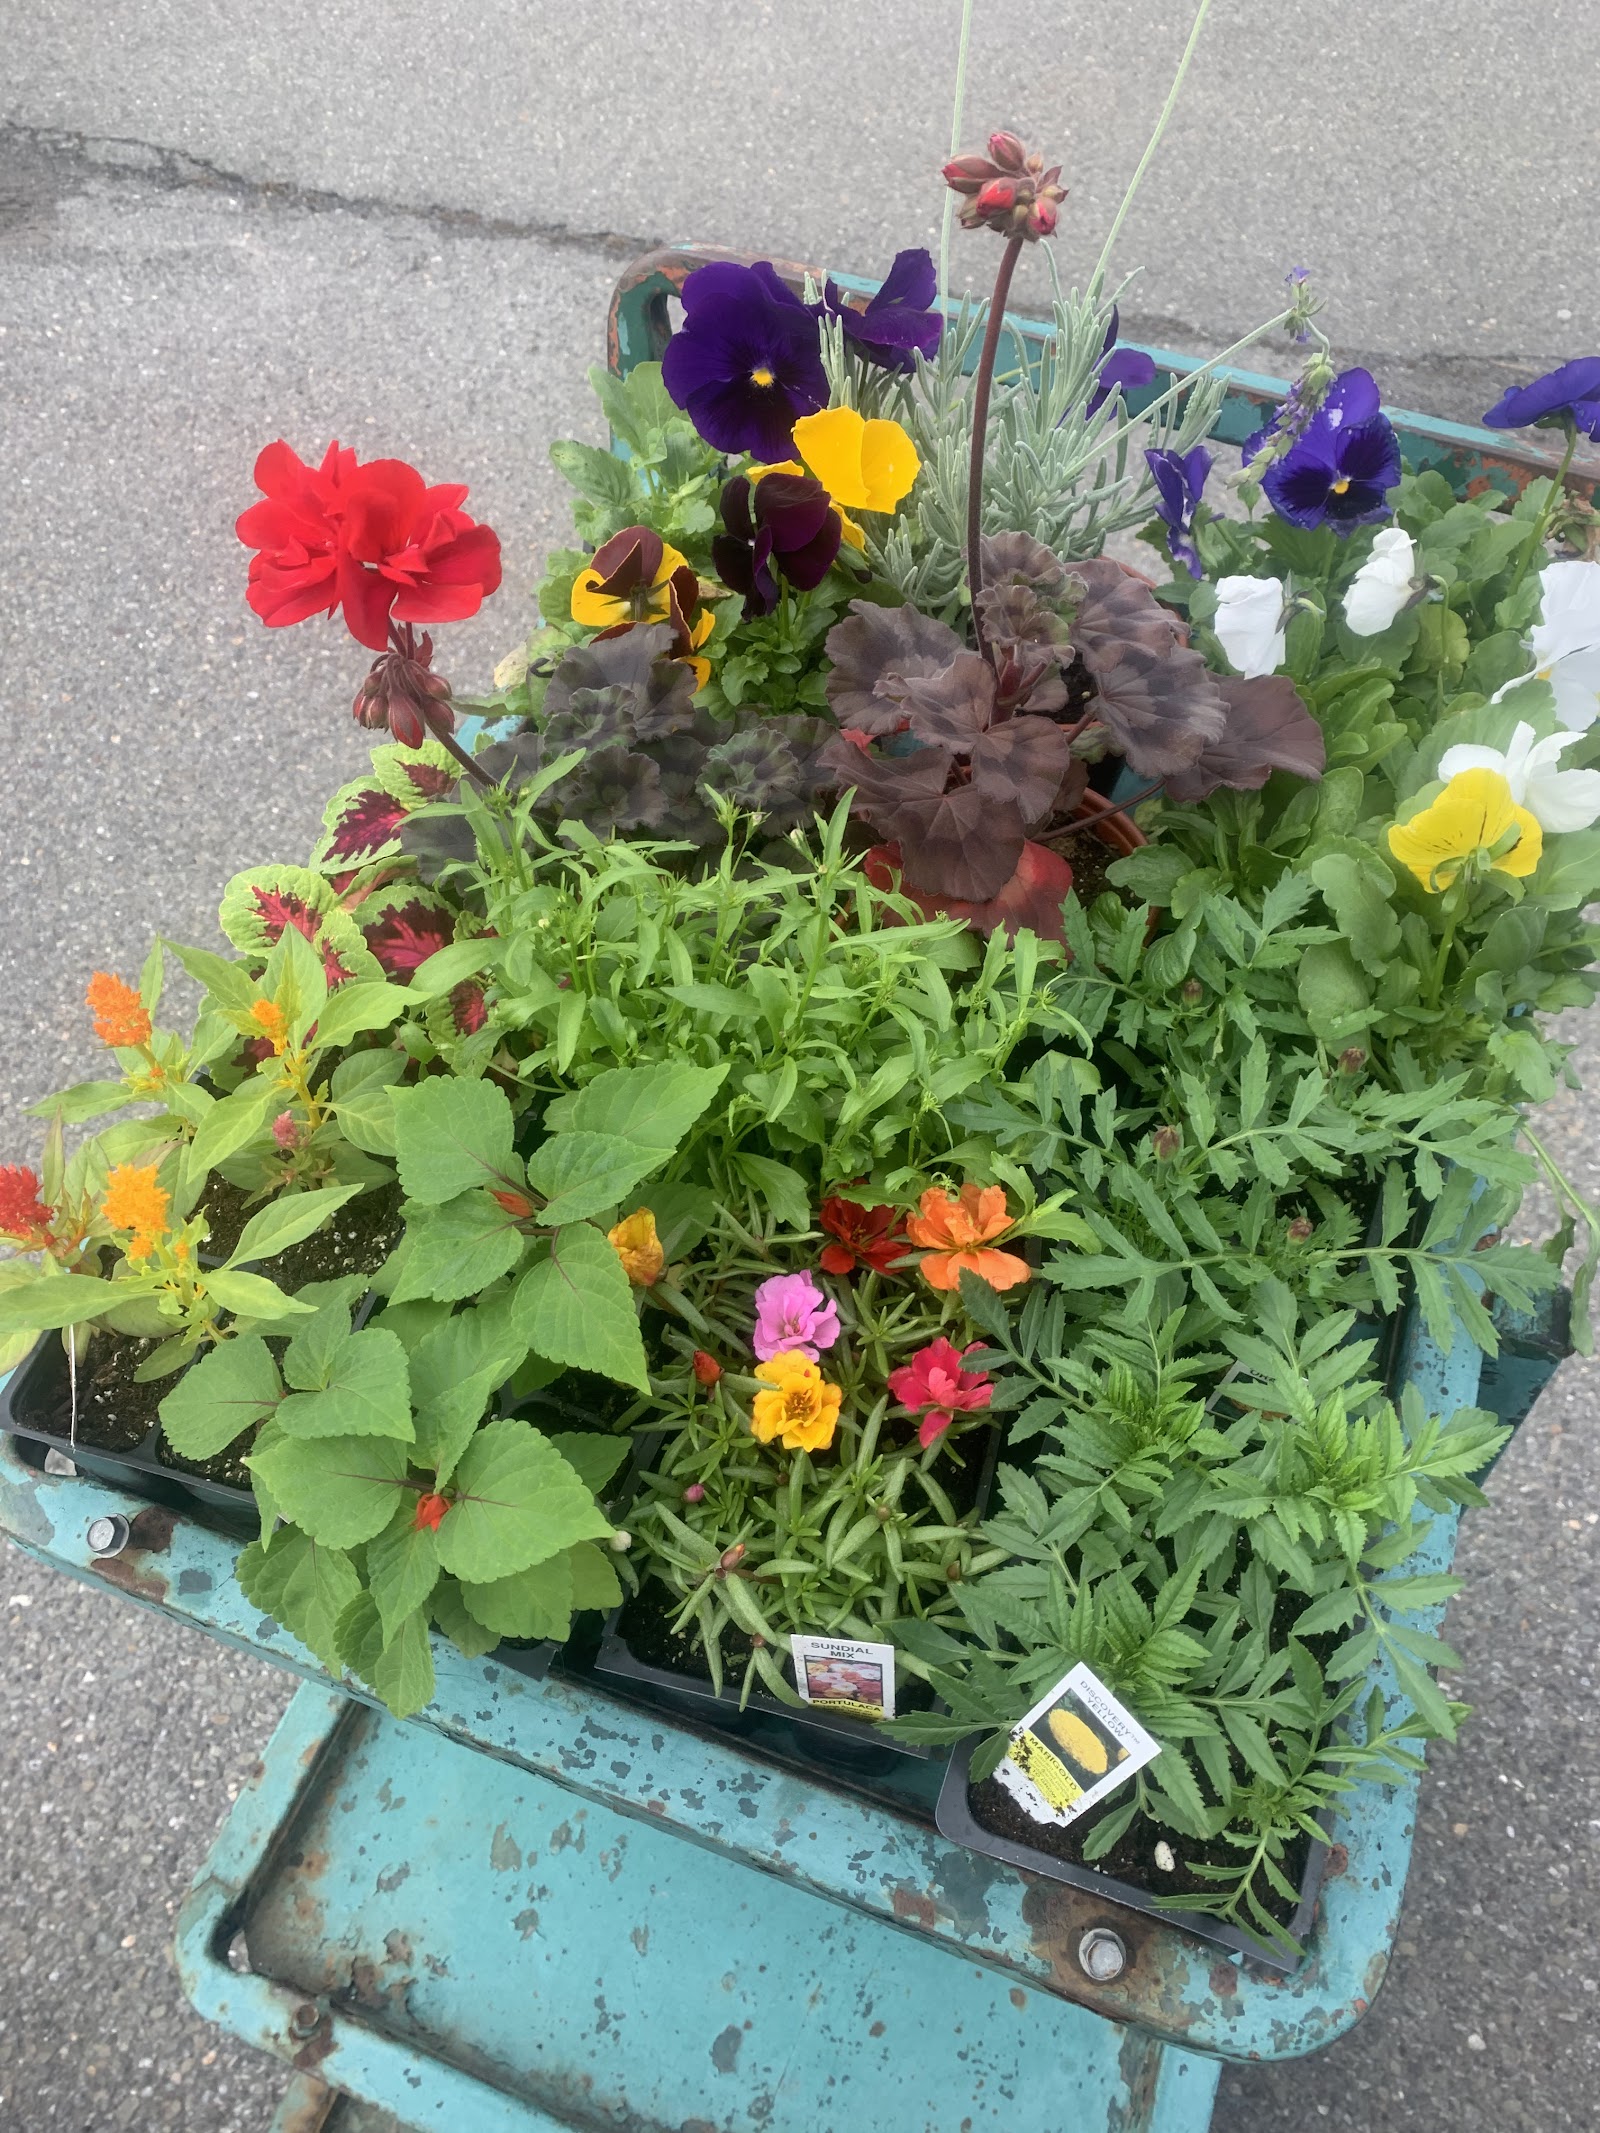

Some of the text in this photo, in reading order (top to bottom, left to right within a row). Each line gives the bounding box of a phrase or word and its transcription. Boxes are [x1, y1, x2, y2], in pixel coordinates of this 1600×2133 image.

[811, 1642, 873, 1655] SUNDIAL
[830, 1650, 855, 1659] MIX
[812, 1699, 881, 1712] PORTULACA
[1087, 1696, 1124, 1737] YELLOW
[1029, 1736, 1077, 1791] MARIGOLD
